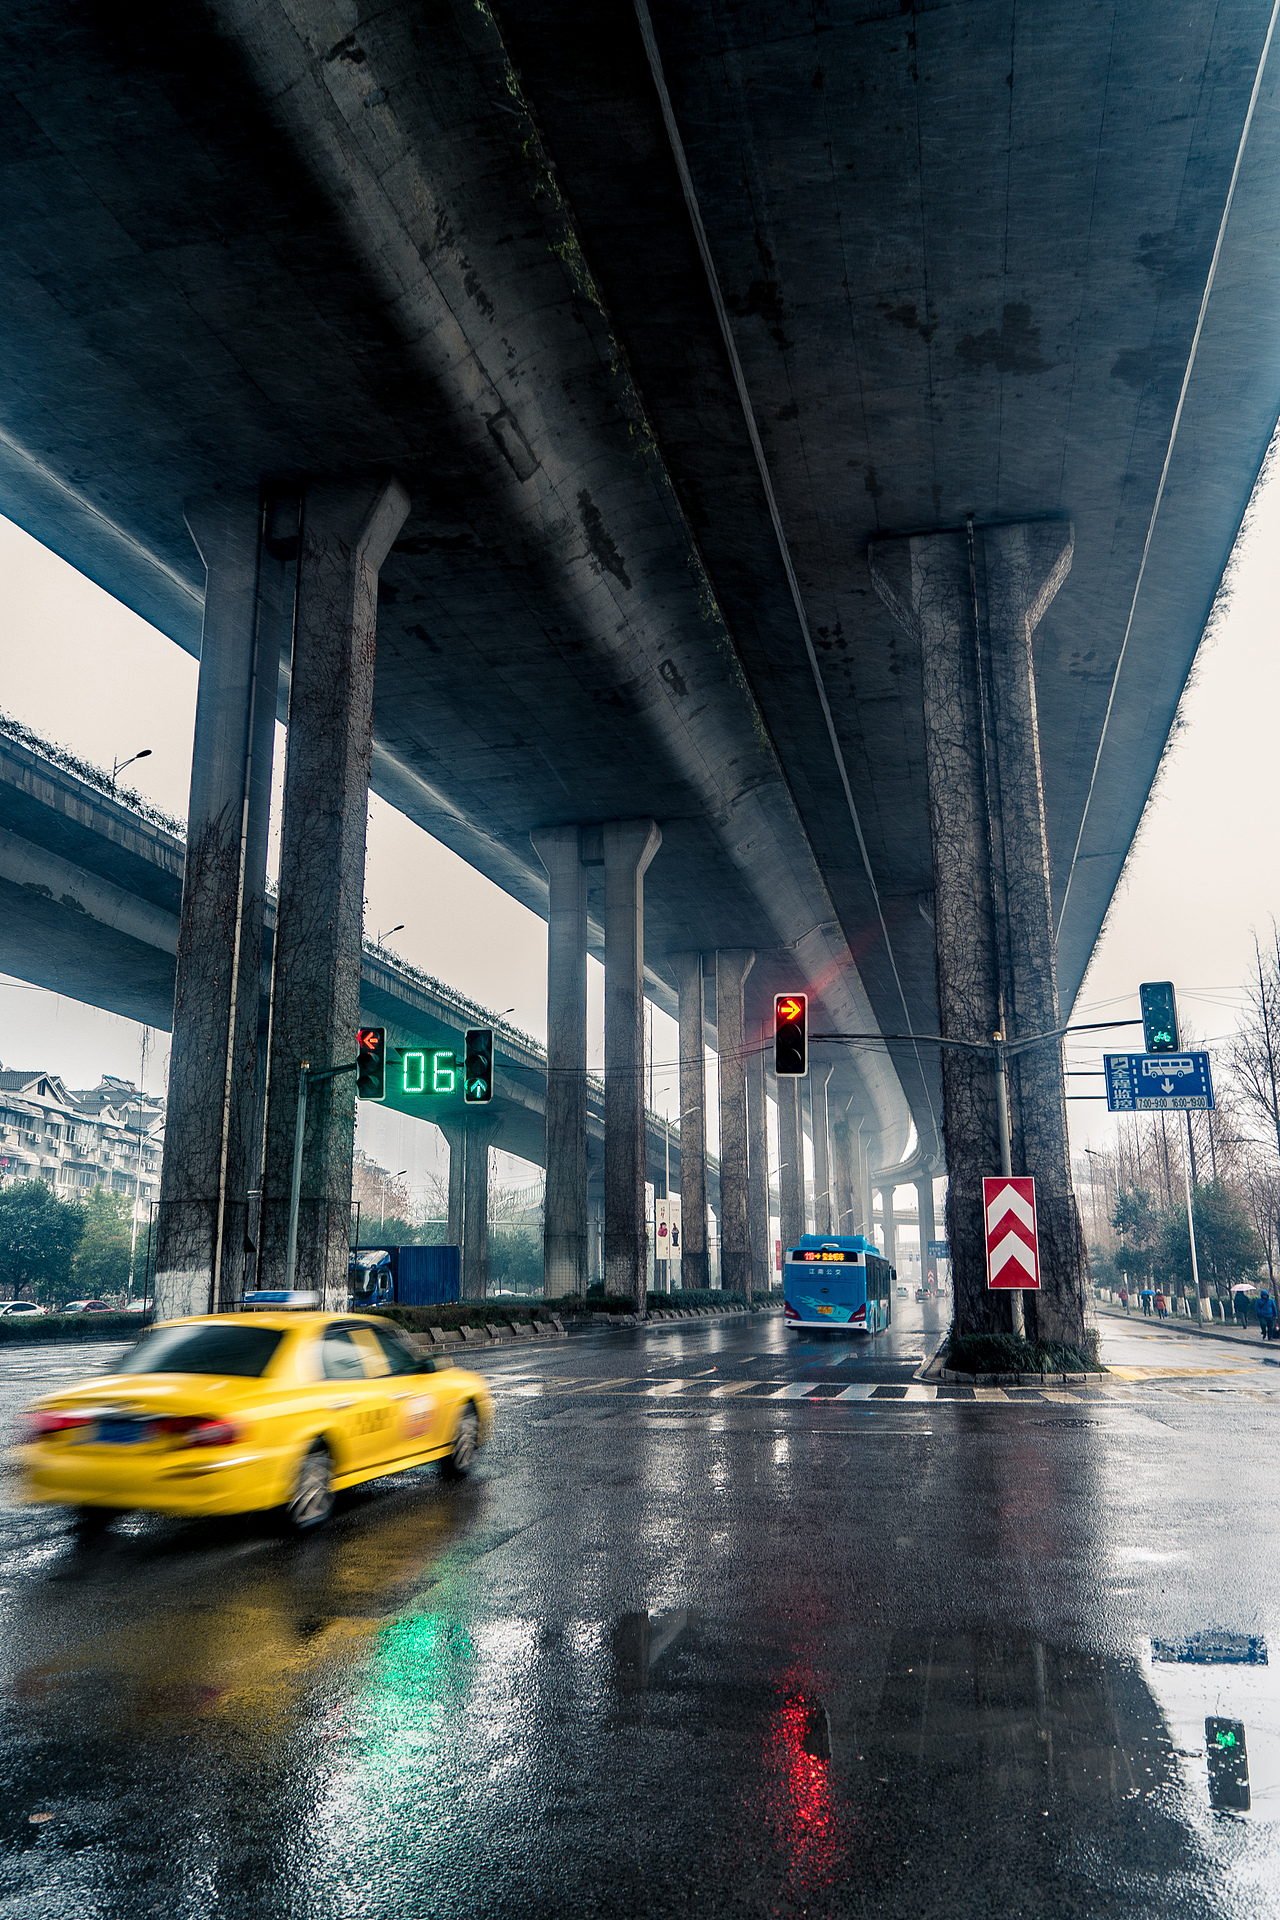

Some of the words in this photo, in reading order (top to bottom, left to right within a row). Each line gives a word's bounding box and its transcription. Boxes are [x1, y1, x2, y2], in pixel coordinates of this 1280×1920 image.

[403, 1052, 454, 1092] 06
[1111, 1068, 1133, 1109] 全程监控
[1138, 1098, 1168, 1108] 7:00-9:00
[1171, 1097, 1205, 1107] 16:00-19:00
